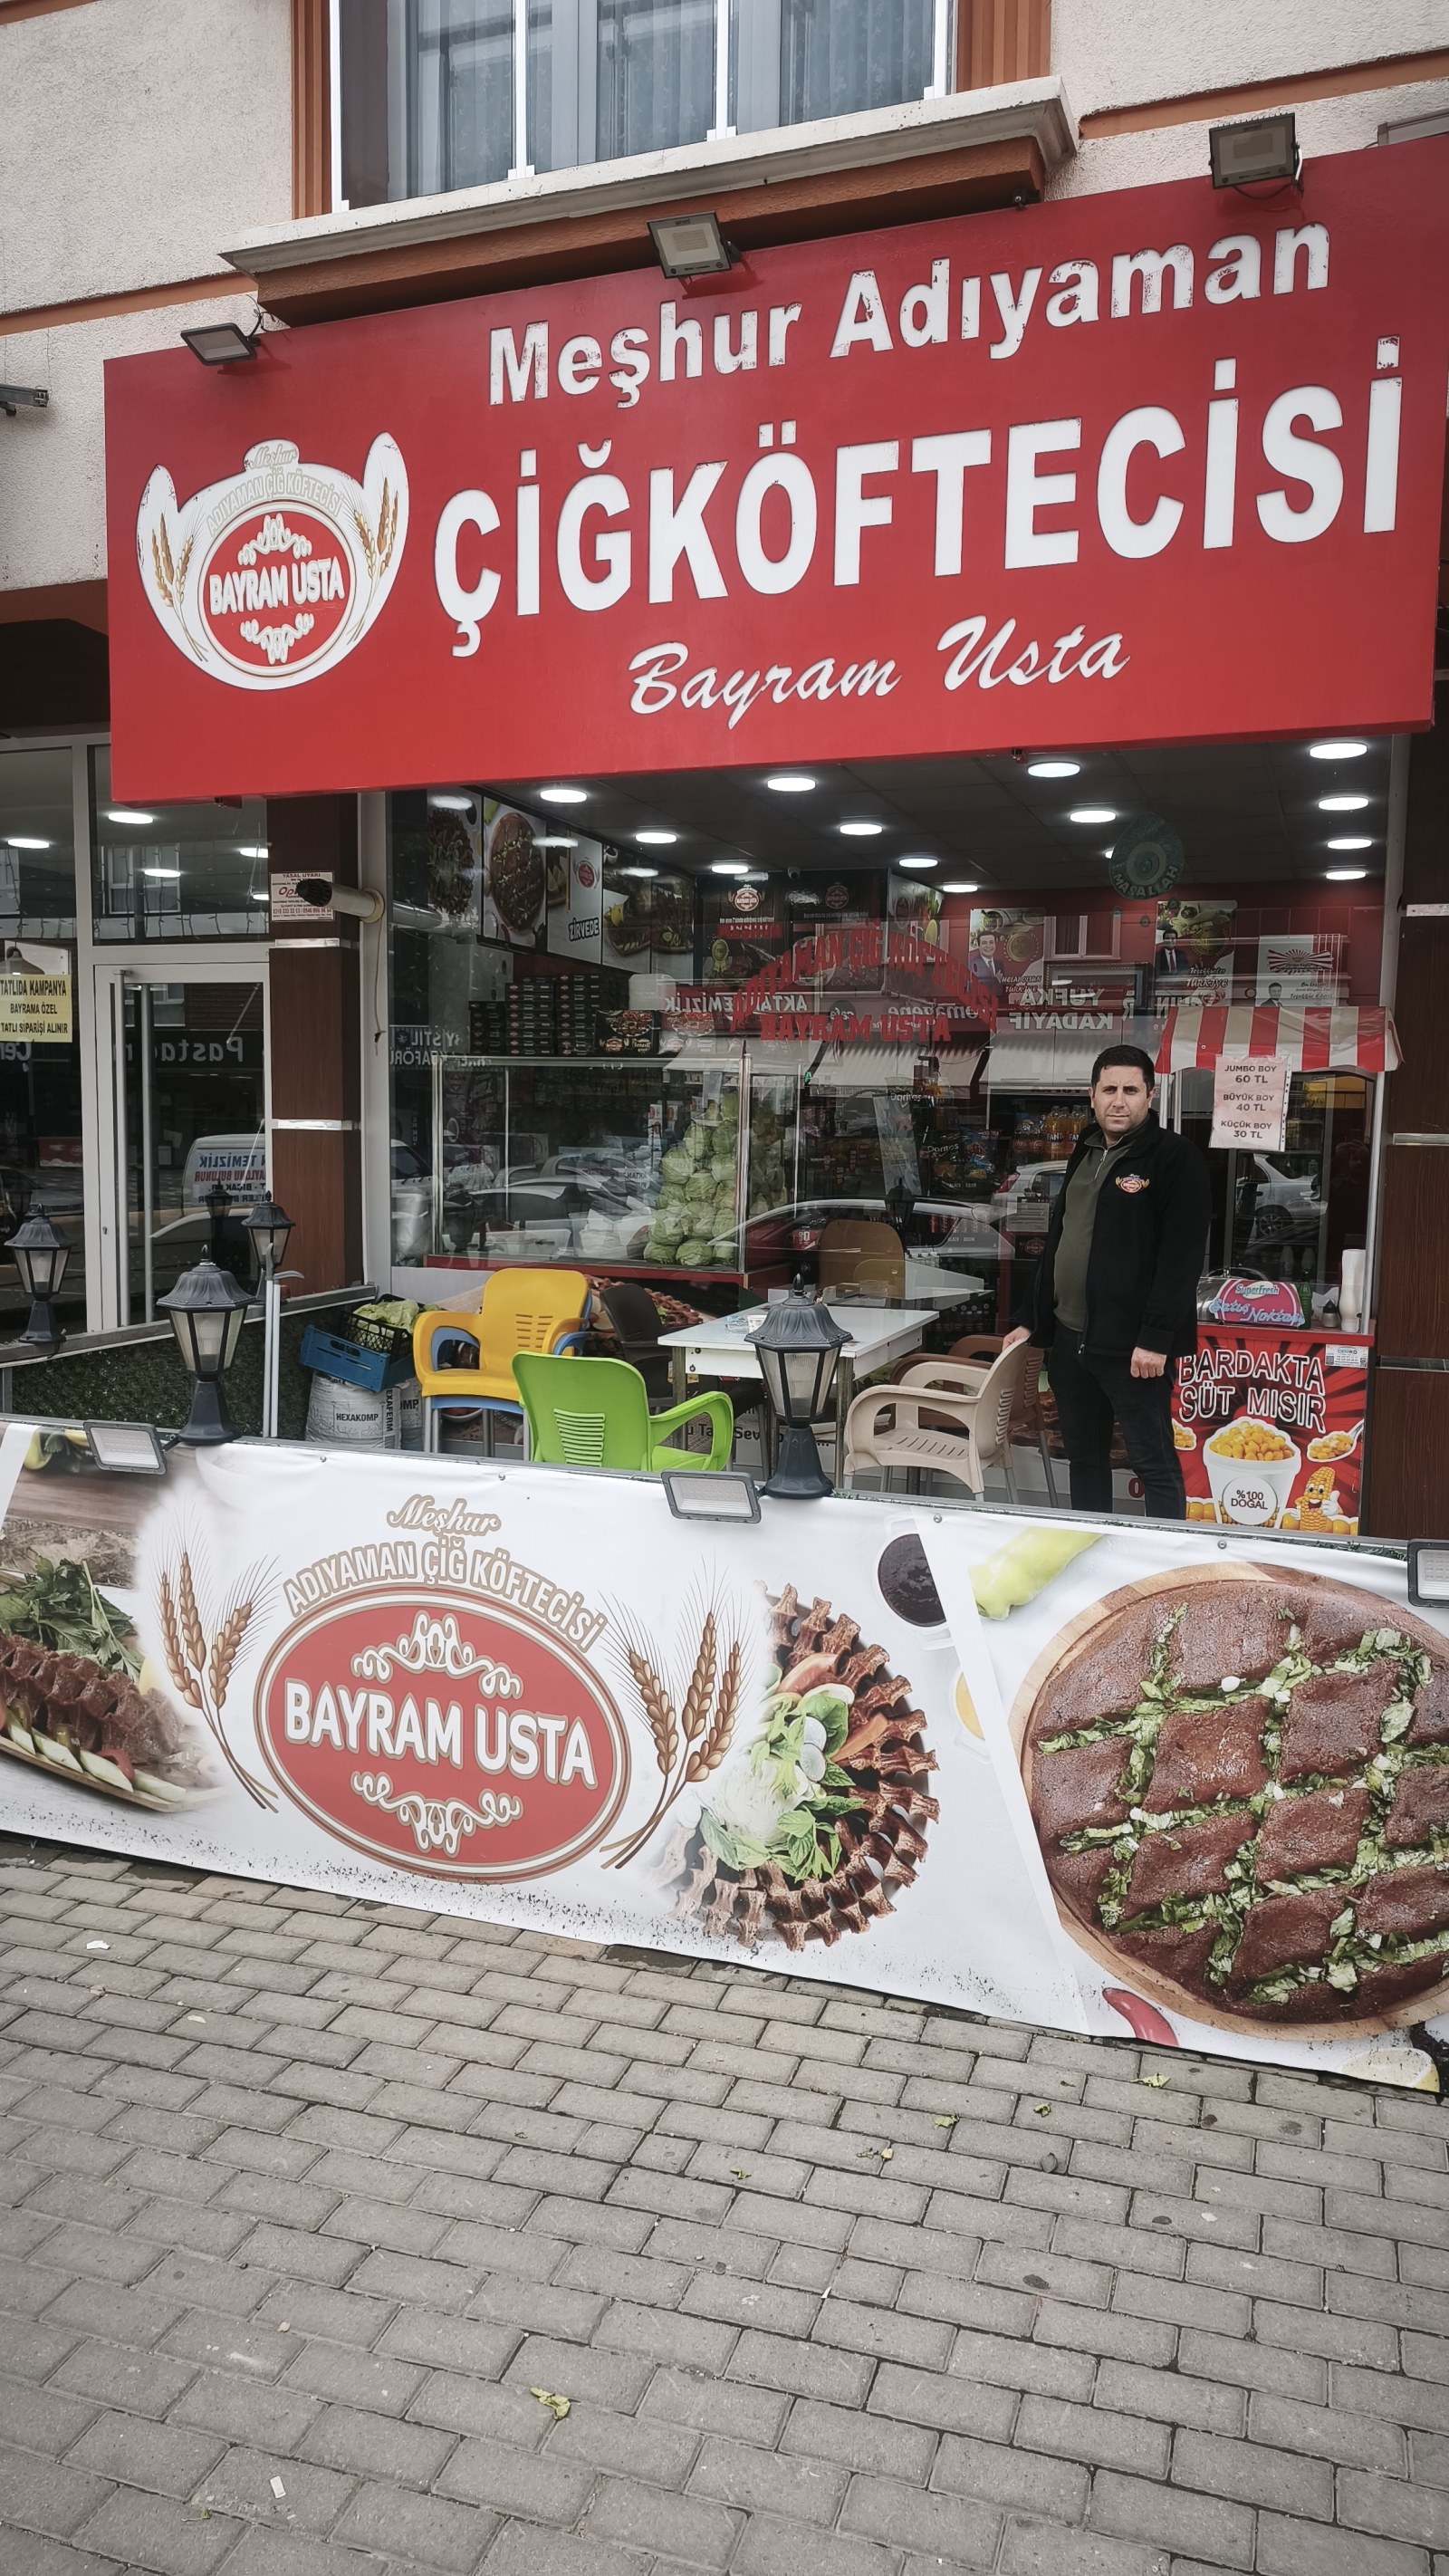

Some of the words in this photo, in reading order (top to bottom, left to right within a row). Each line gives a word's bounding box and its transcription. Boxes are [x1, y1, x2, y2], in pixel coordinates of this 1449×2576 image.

[489, 301, 802, 409] Meşhur
[830, 222, 1330, 360] Adıyaman
[250, 444, 297, 469] Meşhur
[206, 482, 265, 536] ADIYAMAN
[266, 467, 284, 500] ÇİĞ
[287, 469, 346, 516] KÖFTECİSİ
[435, 334, 1403, 657] ÇİĞKÖFTECİSİ
[209, 564, 289, 615] BAYRAM
[292, 556, 345, 604] USTA
[629, 641, 901, 730] Bayram
[937, 614, 1130, 690] Usta
[569, 918, 600, 941] ZİRVEDE
[0, 980, 27, 995] TATLIDA
[30, 980, 66, 995] KAMPANYA
[730, 930, 844, 1033] ADIYAMAN
[10, 1003, 40, 1014] BAYRAMA
[42, 1002, 57, 1014] ÖZEL
[1, 1023, 17, 1033] TATLI
[19, 1020, 45, 1035] SİPARİŞİ
[47, 1023, 68, 1033] ALINIR
[760, 1014, 872, 1041] BAYRAM
[880, 1014, 951, 1042] USTA
[1235, 1075, 1251, 1083] 60
[1254, 1075, 1268, 1083] TL
[1223, 1092, 1254, 1101] BÜYÜK
[1236, 1103, 1251, 1111] 40
[1253, 1103, 1266, 1111] TL
[1221, 1120, 1252, 1129] KÜÇÜK
[1233, 1130, 1247, 1139] 30
[1251, 1131, 1263, 1139] TL
[927, 1142, 959, 1154] Doritos
[1179, 1349, 1326, 1397] BARDAKTA
[336, 1412, 379, 1422] HEXAKOMP
[1179, 1380, 1235, 1423] SÜT
[1246, 1387, 1327, 1434] MISIR
[1236, 1489, 1264, 1501] %100
[387, 1495, 502, 1537] Meşhur
[284, 1542, 417, 1617] ADIYAMAN
[421, 1534, 467, 1585] ÇİĞ
[471, 1548, 608, 1653] KÖFTECİSİ
[285, 1680, 463, 1768] BAYRAM
[475, 1706, 599, 1790] USTA
